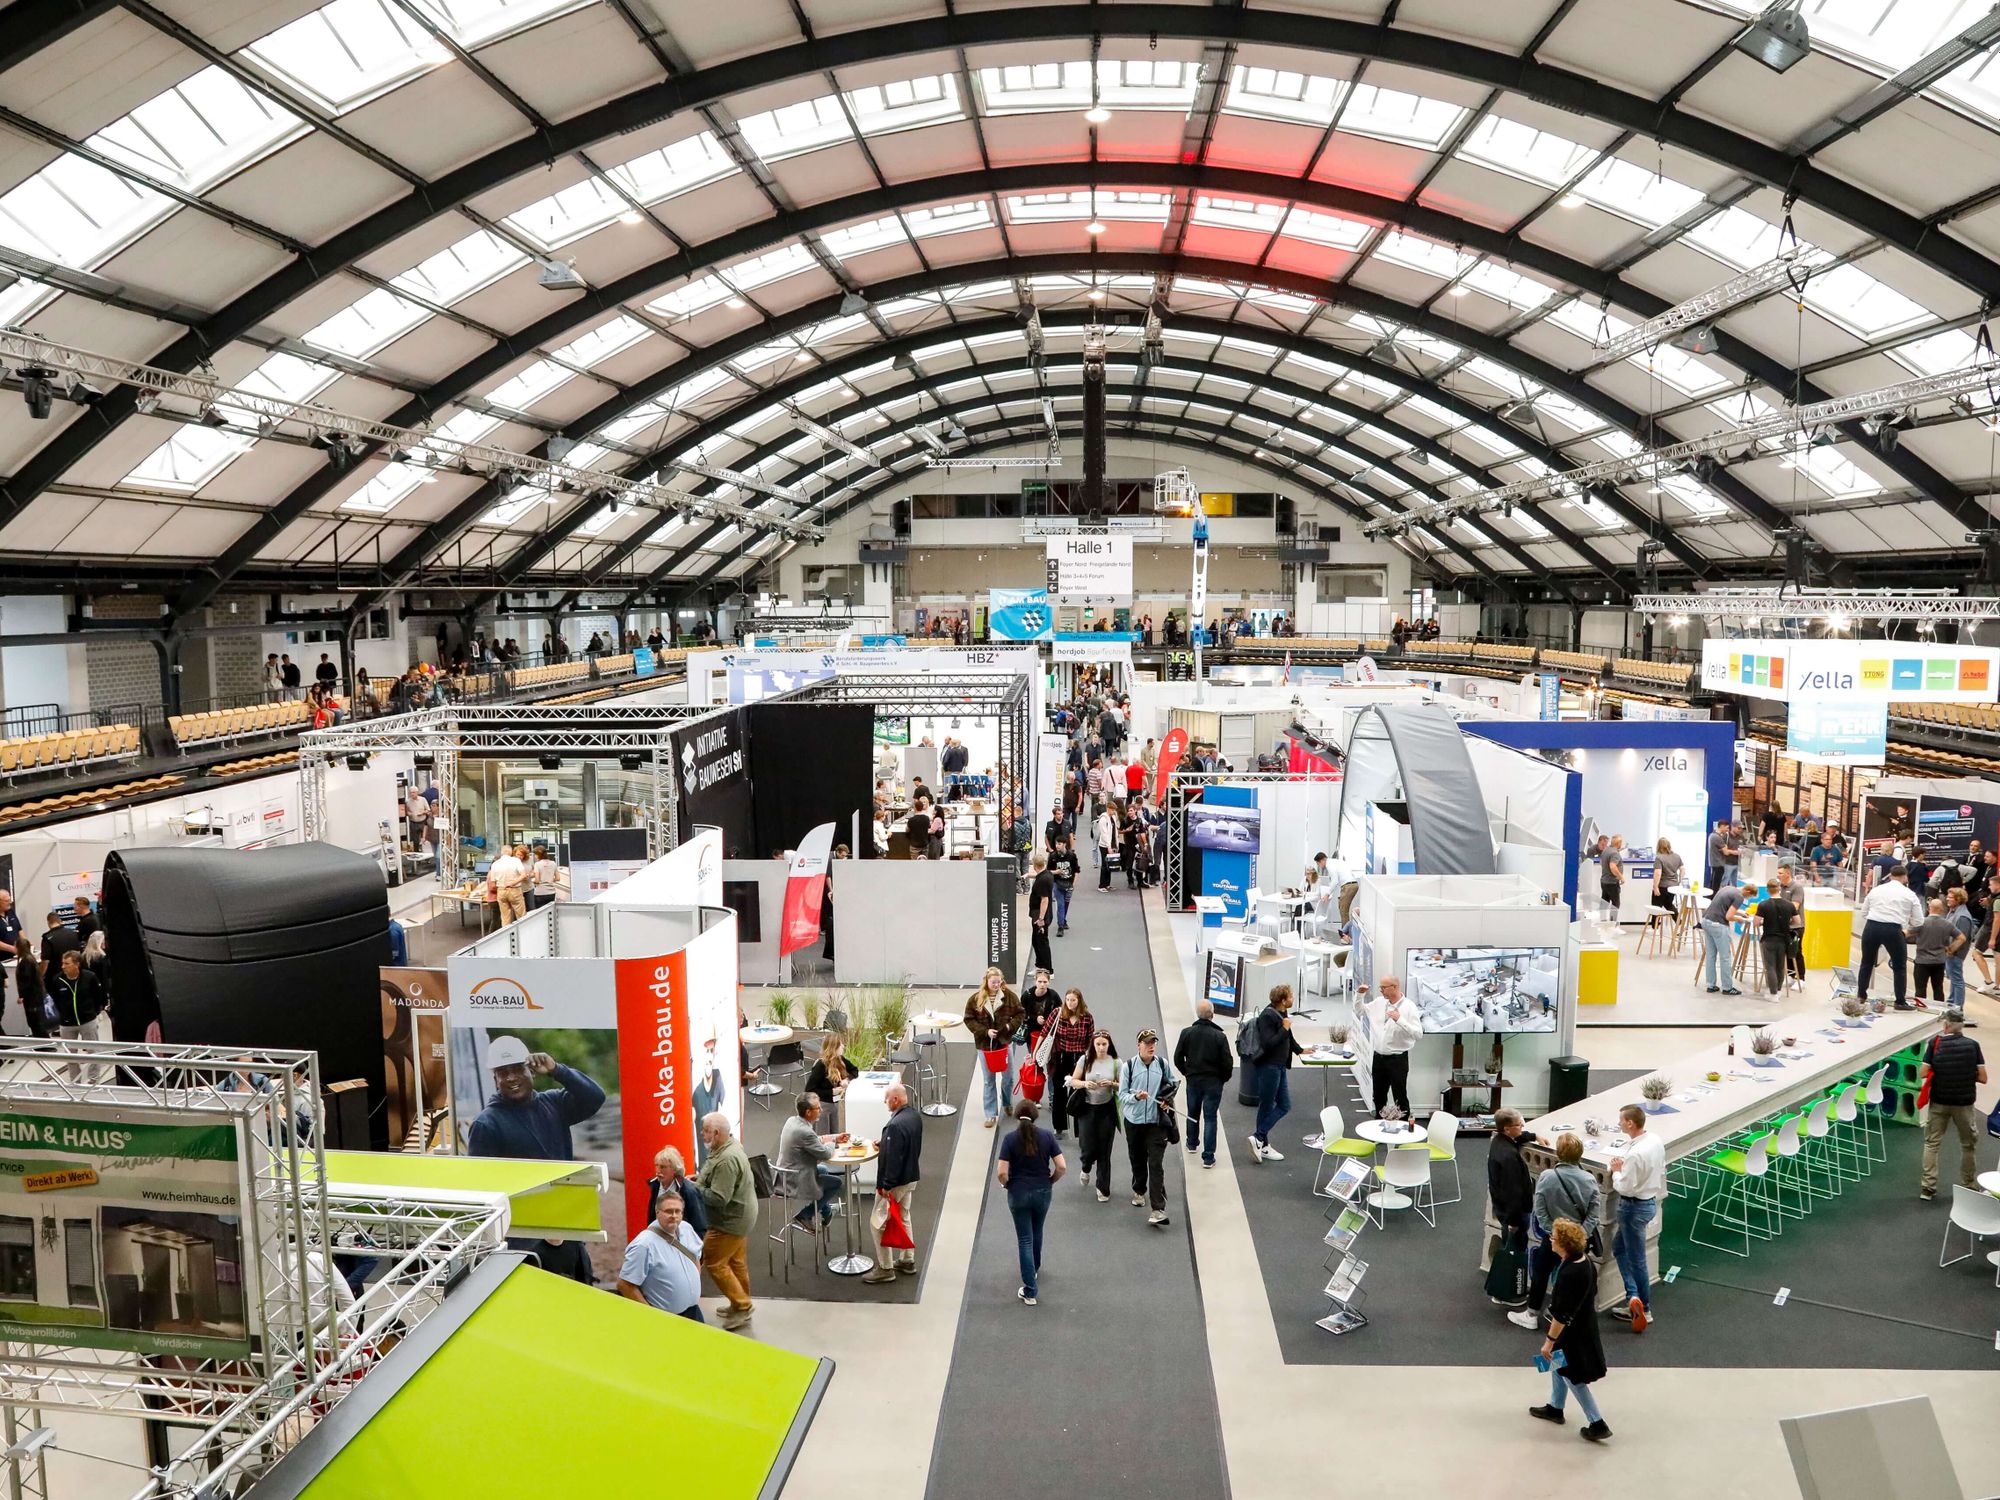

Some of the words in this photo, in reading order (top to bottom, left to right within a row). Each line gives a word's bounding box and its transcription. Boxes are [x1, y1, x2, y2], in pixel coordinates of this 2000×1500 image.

[1067, 541, 1102, 554] Halle
[1107, 541, 1112, 554] 1
[1027, 596, 1046, 604] BAU
[696, 726, 728, 758] INITIATIVE
[699, 755, 733, 791] BAUWESEN
[1001, 902, 1009, 952] WERKSTATT
[991, 917, 999, 963] ENTWURFS
[389, 997, 445, 1009] MADONDA
[469, 995, 525, 1006] SOKA-BAU
[649, 966, 676, 1126] soka-bau.de
[0, 1120, 38, 1142] EIM
[44, 1125, 58, 1145] &
[0, 1160, 25, 1174] rvice
[26, 1177, 53, 1188] Direkt
[55, 1174, 67, 1185] ab
[68, 1170, 94, 1183] Werk!
[141, 1189, 237, 1206] www.heimhaus.de
[152, 1337, 203, 1350] Vordächer
